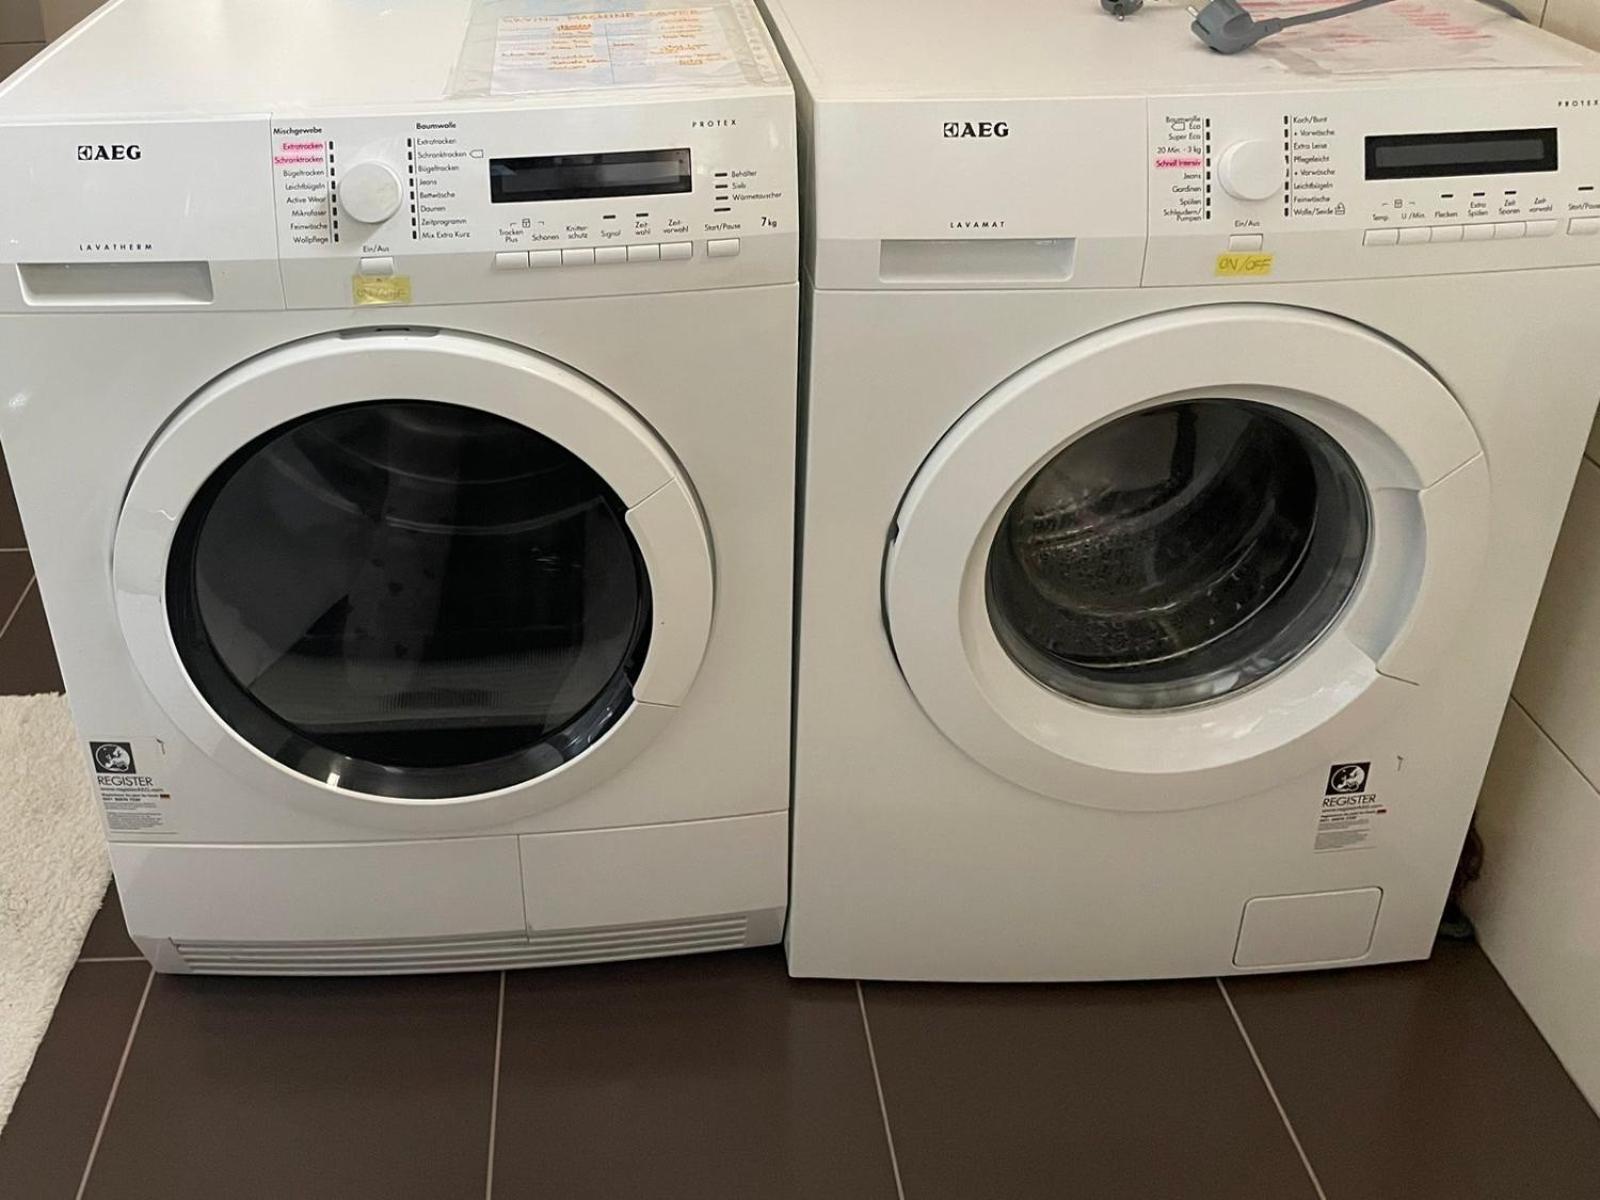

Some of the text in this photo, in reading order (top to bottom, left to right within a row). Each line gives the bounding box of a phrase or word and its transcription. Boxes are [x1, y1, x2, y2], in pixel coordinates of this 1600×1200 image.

[416, 121, 456, 130] Baumwolle
[692, 119, 737, 128] PROTEX
[273, 126, 323, 136] Mischgewebe
[960, 122, 1009, 138] AEG
[282, 142, 324, 151] Extratrocken
[416, 138, 457, 146] Extratrocken
[94, 145, 142, 160] AEG
[418, 149, 467, 159] Schranktrocken
[274, 155, 324, 164] Schranktrocken
[283, 168, 325, 178] Bügeltrocken
[418, 163, 459, 174] Bügeltrocken
[286, 196, 306, 204] Active
[291, 208, 328, 218] Mikrofaser
[420, 204, 446, 213] Daunen
[290, 222, 328, 231] Feinwäsche
[421, 218, 467, 227] Zeitprogramm
[950, 221, 1005, 229] LAVAMAT
[704, 223, 742, 232] Start/Pause
[293, 235, 329, 245] Wollpflege
[79, 243, 152, 251] LAVATHERM
[362, 245, 390, 253] Ein/Aus
[97, 775, 153, 787] REGISTER
[1322, 794, 1377, 807] REGISTER
